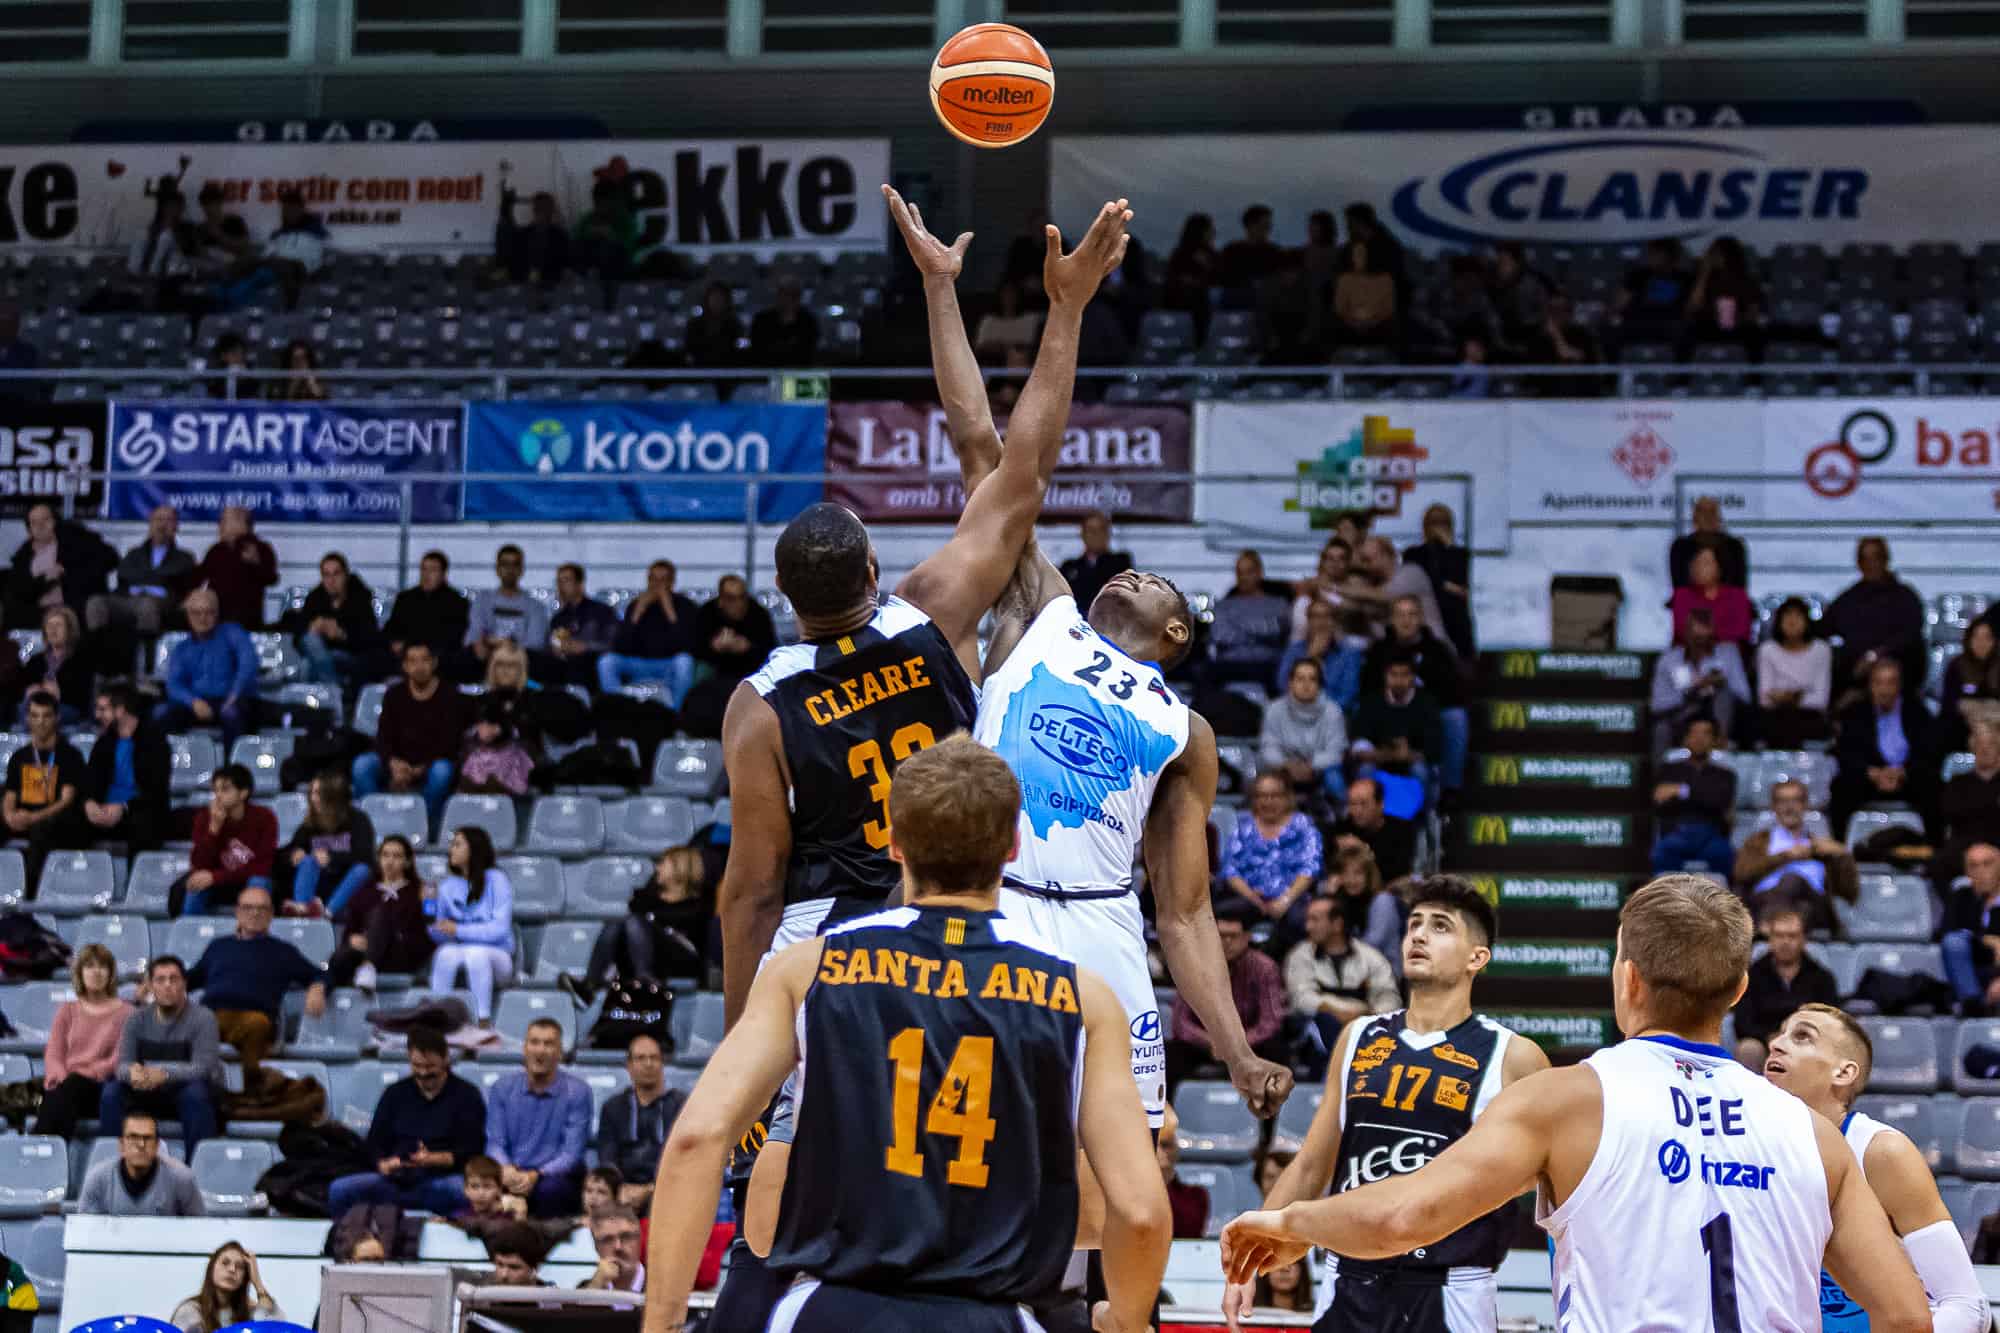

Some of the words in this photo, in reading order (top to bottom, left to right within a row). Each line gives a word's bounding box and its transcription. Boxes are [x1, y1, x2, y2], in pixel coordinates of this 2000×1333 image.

[963, 87, 1035, 104] molten
[1524, 107, 1748, 128] GRADA
[238, 121, 439, 141] GRADA
[347, 179, 408, 202] com
[416, 174, 484, 203] nou!
[1490, 171, 1869, 220] CLANSER
[170, 413, 311, 451] START
[315, 420, 457, 456] ASCENT
[584, 420, 770, 472] kroton
[857, 418, 922, 466] La
[1917, 418, 2000, 465] ba
[804, 655, 931, 726] CLEARE
[1073, 650, 1138, 700] 23
[1028, 712, 1129, 774] DELTECO
[1511, 817, 1622, 836] McDonald's
[1503, 880, 1618, 899] McDonald's
[819, 948, 969, 998] SANTA
[979, 962, 1080, 1013] ANA
[884, 1027, 996, 1188] 14
[1380, 1064, 1433, 1112] 17
[1669, 1086, 1746, 1136] DEE
[1700, 1211, 1743, 1333] 1
